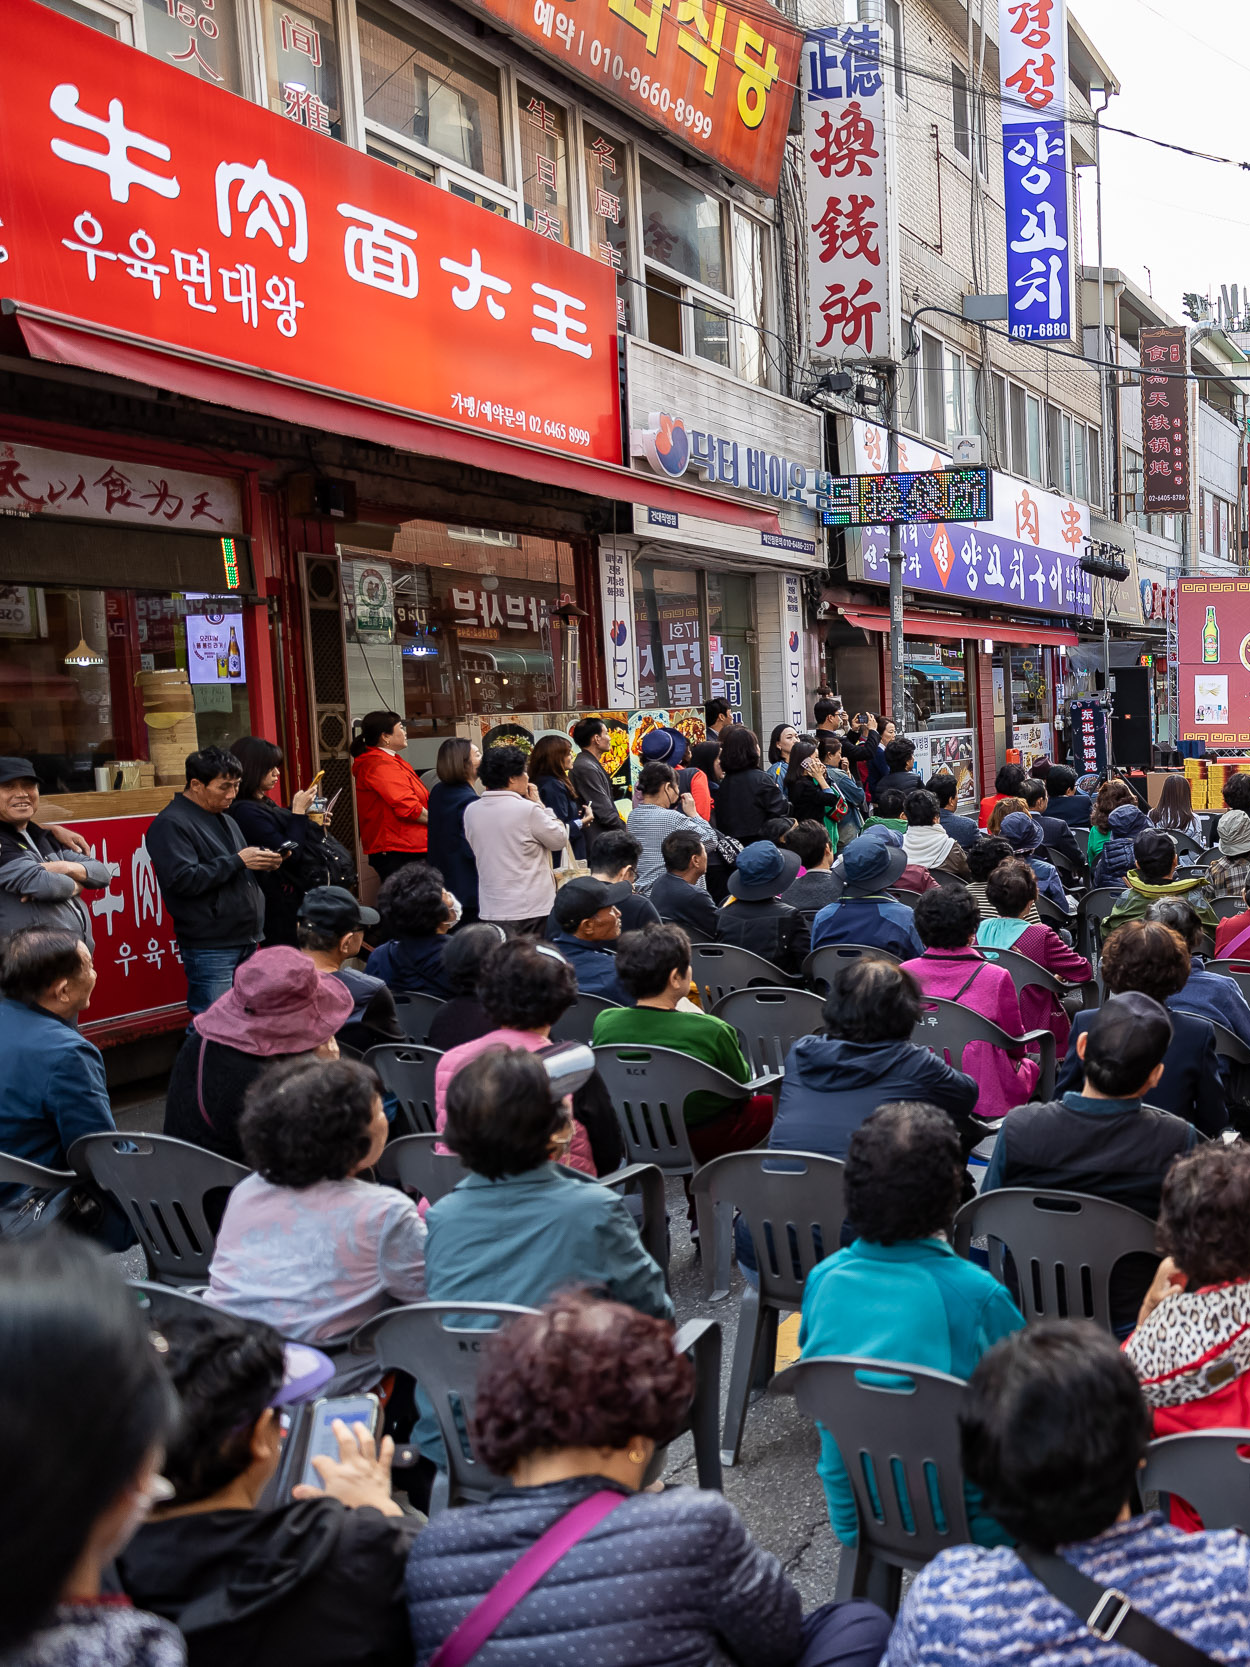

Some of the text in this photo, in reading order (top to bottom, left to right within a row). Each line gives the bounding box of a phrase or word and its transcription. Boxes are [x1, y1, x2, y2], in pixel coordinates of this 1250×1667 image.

[533, 1, 713, 140] 예약 010-9660-8999
[804, 24, 883, 101] 正德
[1005, 0, 1057, 110] 경성
[49, 82, 592, 360] 牛肉面大王
[61, 210, 305, 338] 우육면대왕
[810, 101, 881, 354] 換錢所
[1012, 322, 1068, 339] 467-6880
[451, 392, 590, 447] 가맹/예약문의 02 6465 8999
[650, 509, 678, 527] 건대직영점
